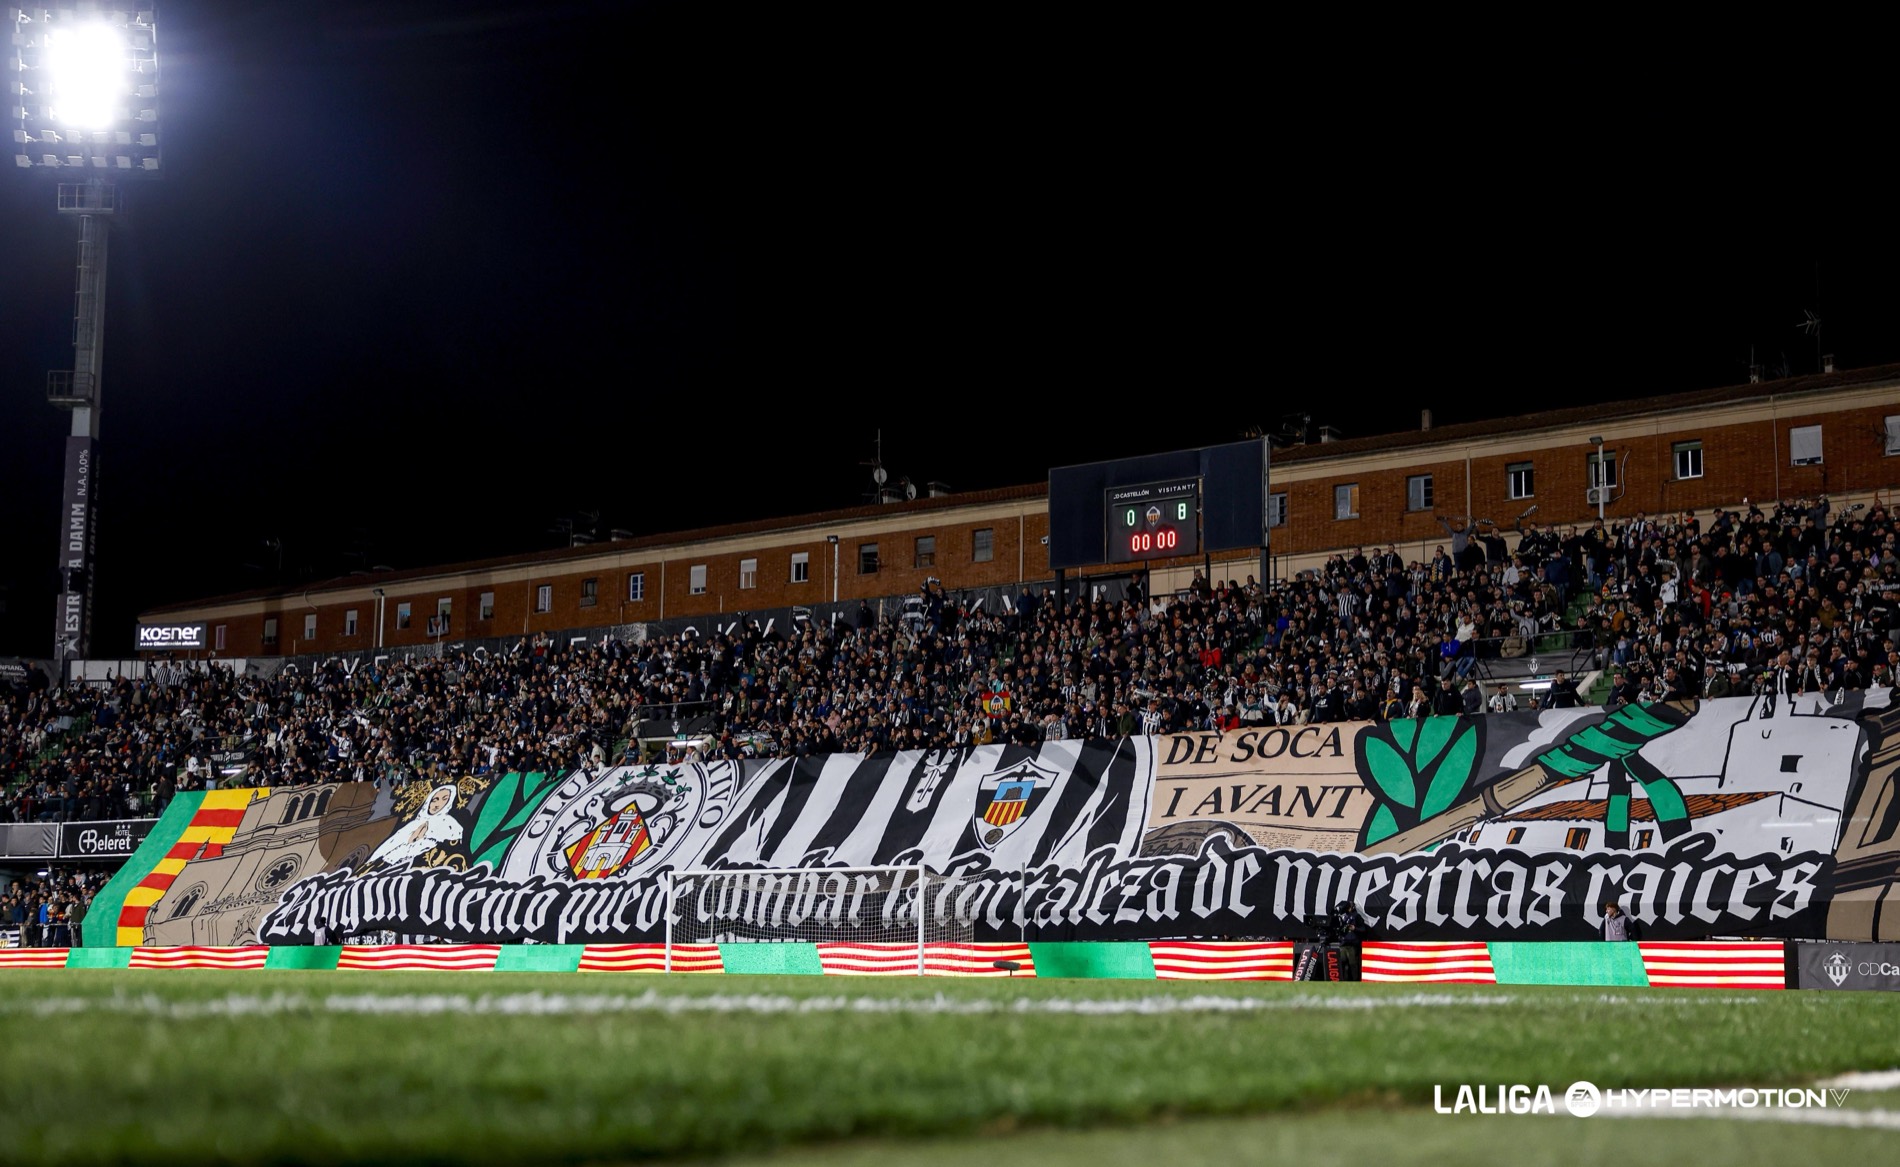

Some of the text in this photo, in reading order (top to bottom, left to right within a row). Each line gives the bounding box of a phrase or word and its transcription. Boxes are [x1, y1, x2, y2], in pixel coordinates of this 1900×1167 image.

[1120, 489, 1150, 498] CASTELLÓN
[1127, 509, 1135, 526] 0
[1178, 503, 1187, 520] 8
[65, 449, 89, 632] ESTRA DAMM N.A. 0,0%
[1132, 531, 1176, 552] 00 00
[1162, 727, 1344, 765] DE SOCA
[1161, 785, 1367, 818] I AVANT
[115, 829, 130, 837] HOTEL
[557, 869, 694, 944] puede
[697, 860, 880, 928] tumbar
[882, 857, 931, 929] la
[935, 859, 1184, 930] fortaleza
[1191, 848, 1262, 919] de
[1273, 856, 1573, 930] nuestras
[1583, 839, 1823, 929] raíces
[1294, 949, 1311, 982] LALIGA
[1326, 951, 1341, 982] LALIGA
